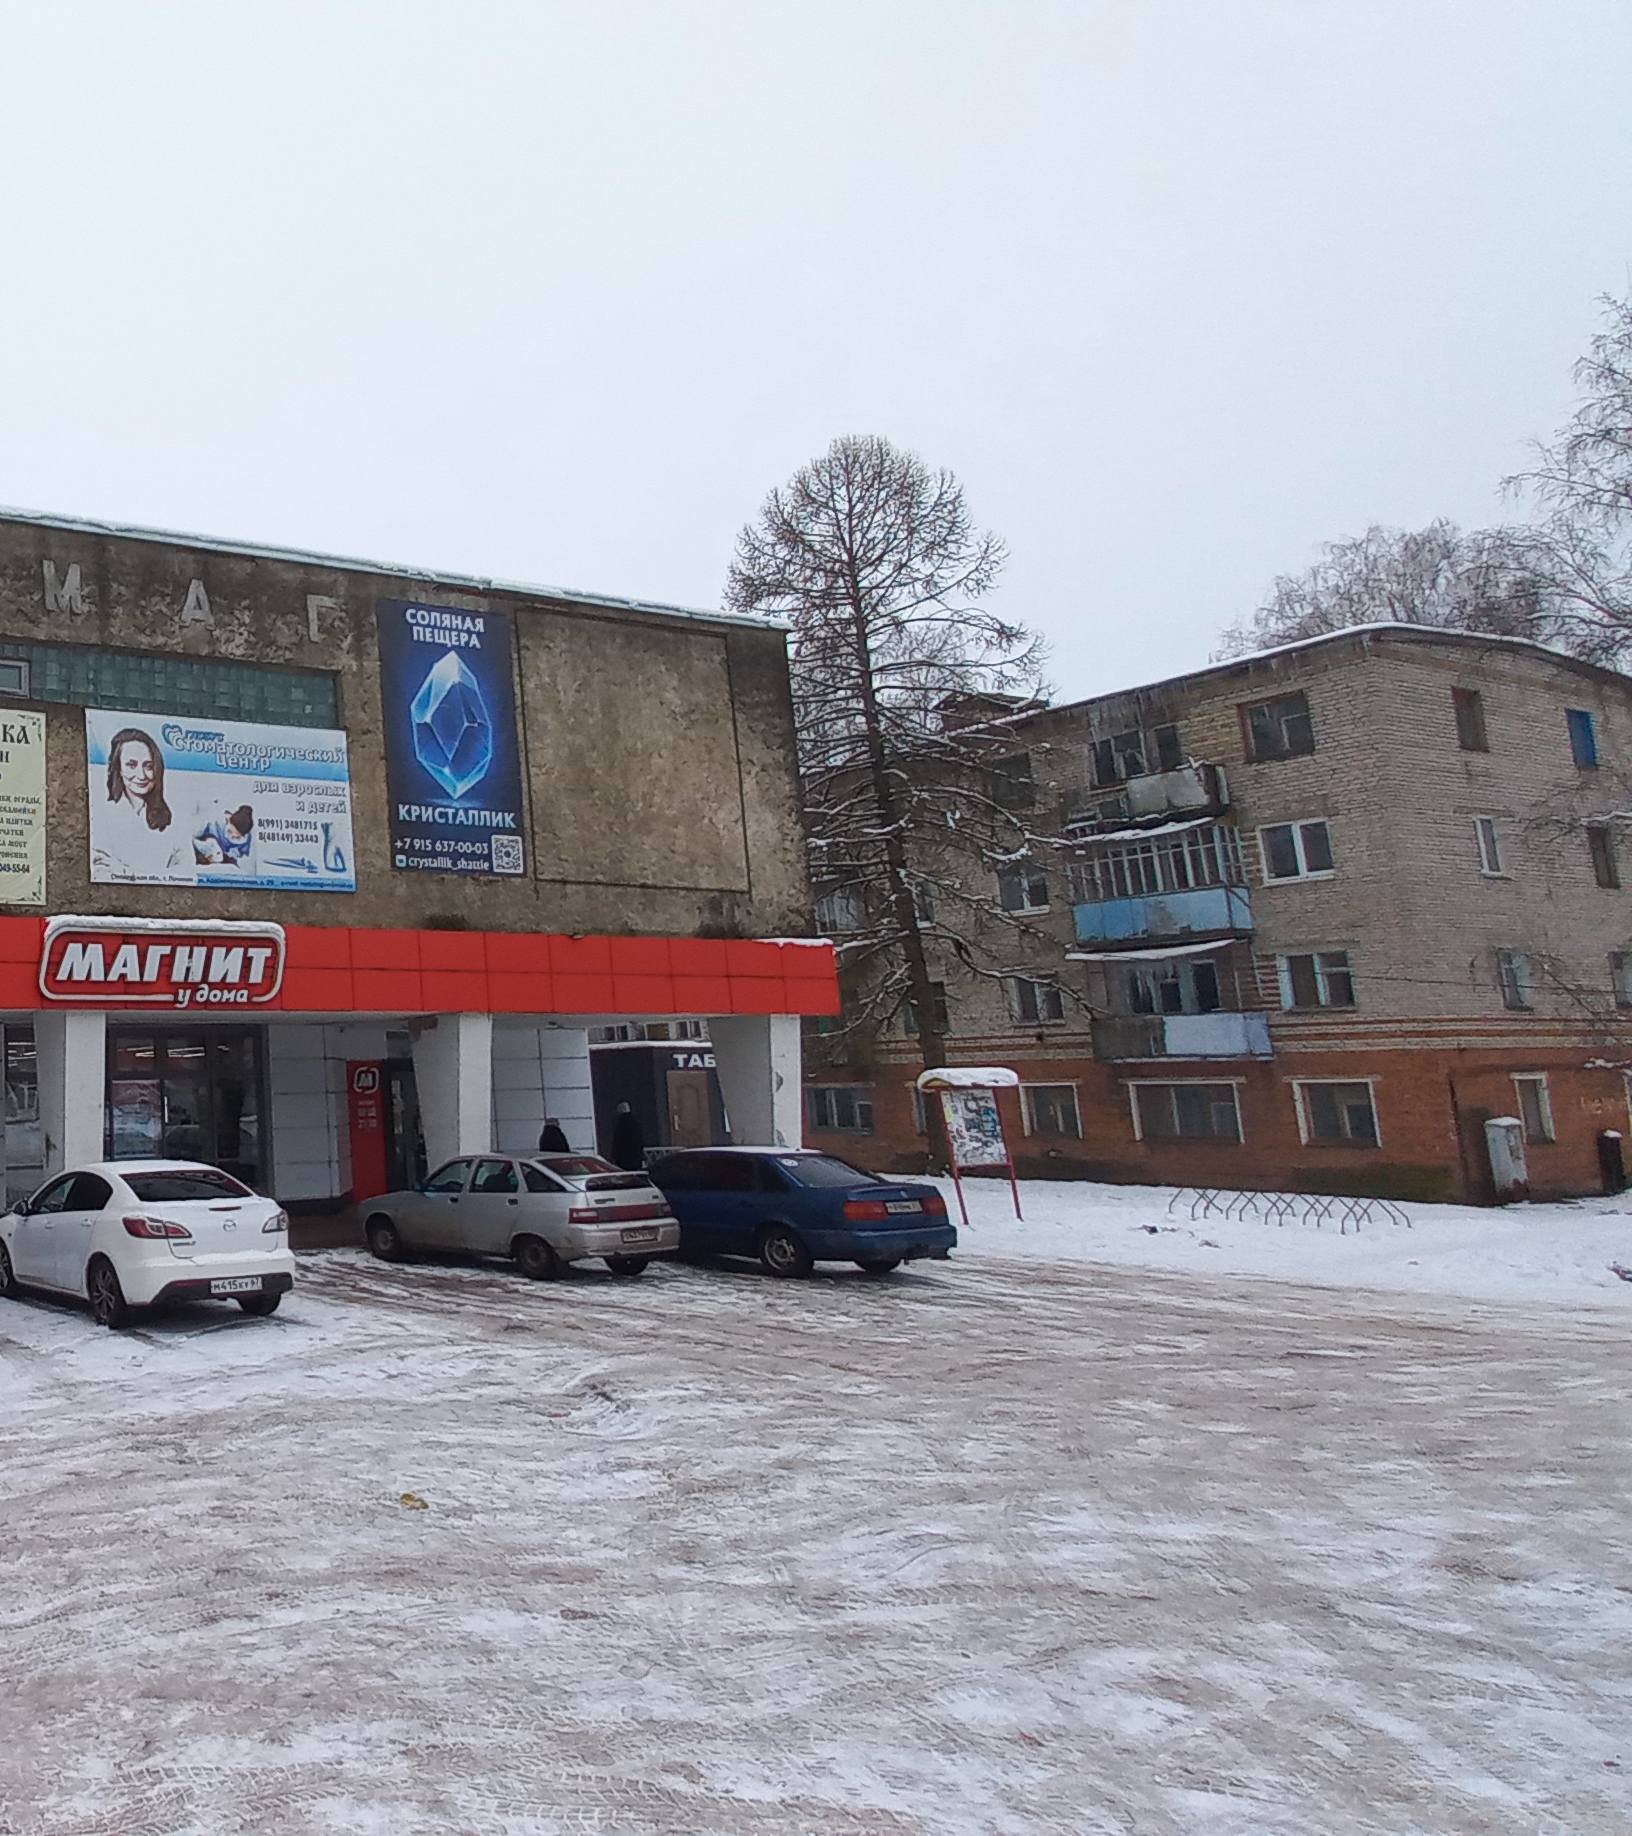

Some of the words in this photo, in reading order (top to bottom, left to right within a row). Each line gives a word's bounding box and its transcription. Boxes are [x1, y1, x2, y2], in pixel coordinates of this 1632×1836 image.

[405, 608, 485, 632] СОЛЯНАЯ
[412, 626, 482, 649] ПЕЩЕРА
[172, 736, 345, 764] Стоматологический
[253, 780, 280, 794] для
[282, 782, 348, 798] взрослых
[296, 801, 306, 812] и
[307, 800, 348, 815] детей
[398, 804, 517, 828] КРИСТАЛЛИК
[394, 838, 411, 850] +7
[413, 838, 432, 851] 915
[435, 840, 489, 854] 637-00-03
[56, 943, 272, 983] МАГНИТ
[173, 988, 192, 1008] у
[196, 983, 249, 1003] дома
